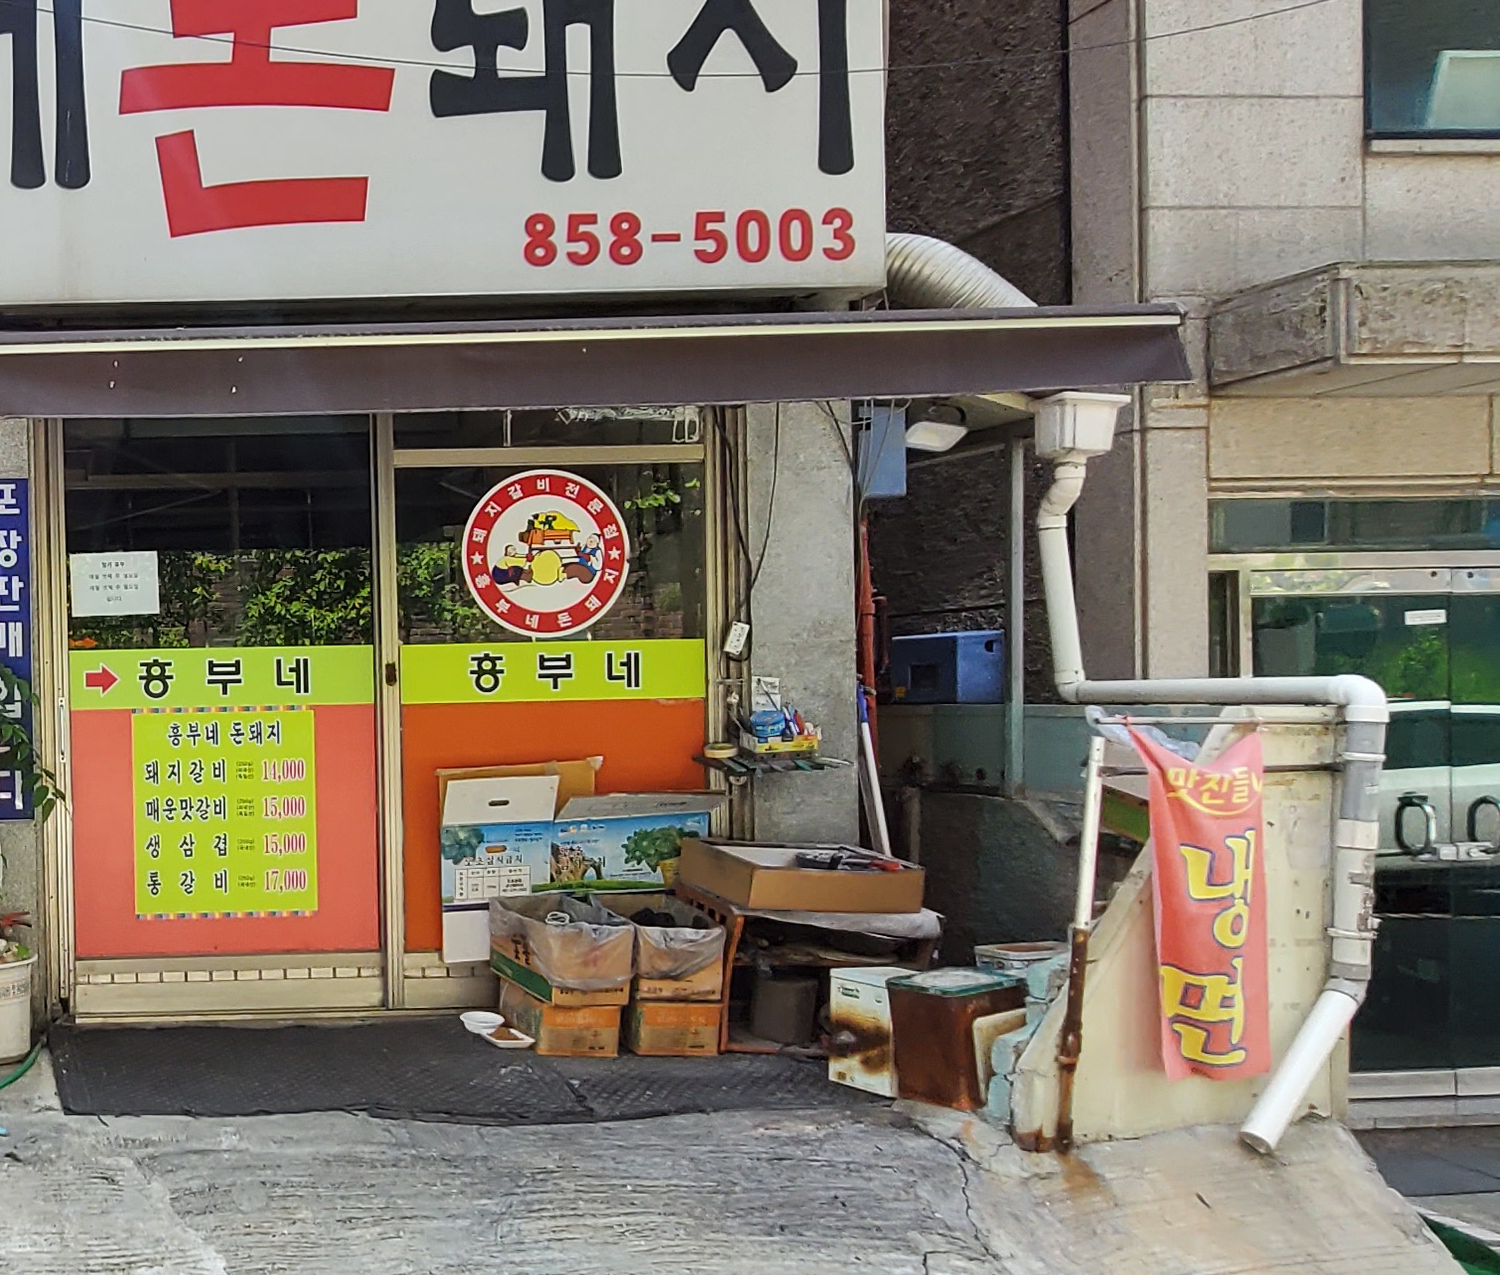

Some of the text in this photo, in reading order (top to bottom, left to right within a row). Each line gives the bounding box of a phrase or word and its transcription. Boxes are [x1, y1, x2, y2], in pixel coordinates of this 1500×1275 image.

[523, 206, 856, 268] 858-5003
[137, 657, 313, 699] 흥부네
[469, 651, 640, 693] 흥부네
[167, 720, 282, 747] 흥부네 돈돼지
[144, 759, 227, 784] 돼지갈비
[261, 758, 306, 783] 14,000
[145, 796, 228, 822] 매운맛갈비
[262, 795, 307, 820] 15,000
[263, 832, 307, 857] 15,000
[263, 869, 308, 893] 17,000
[1160, 827, 1256, 1068] 냉면
